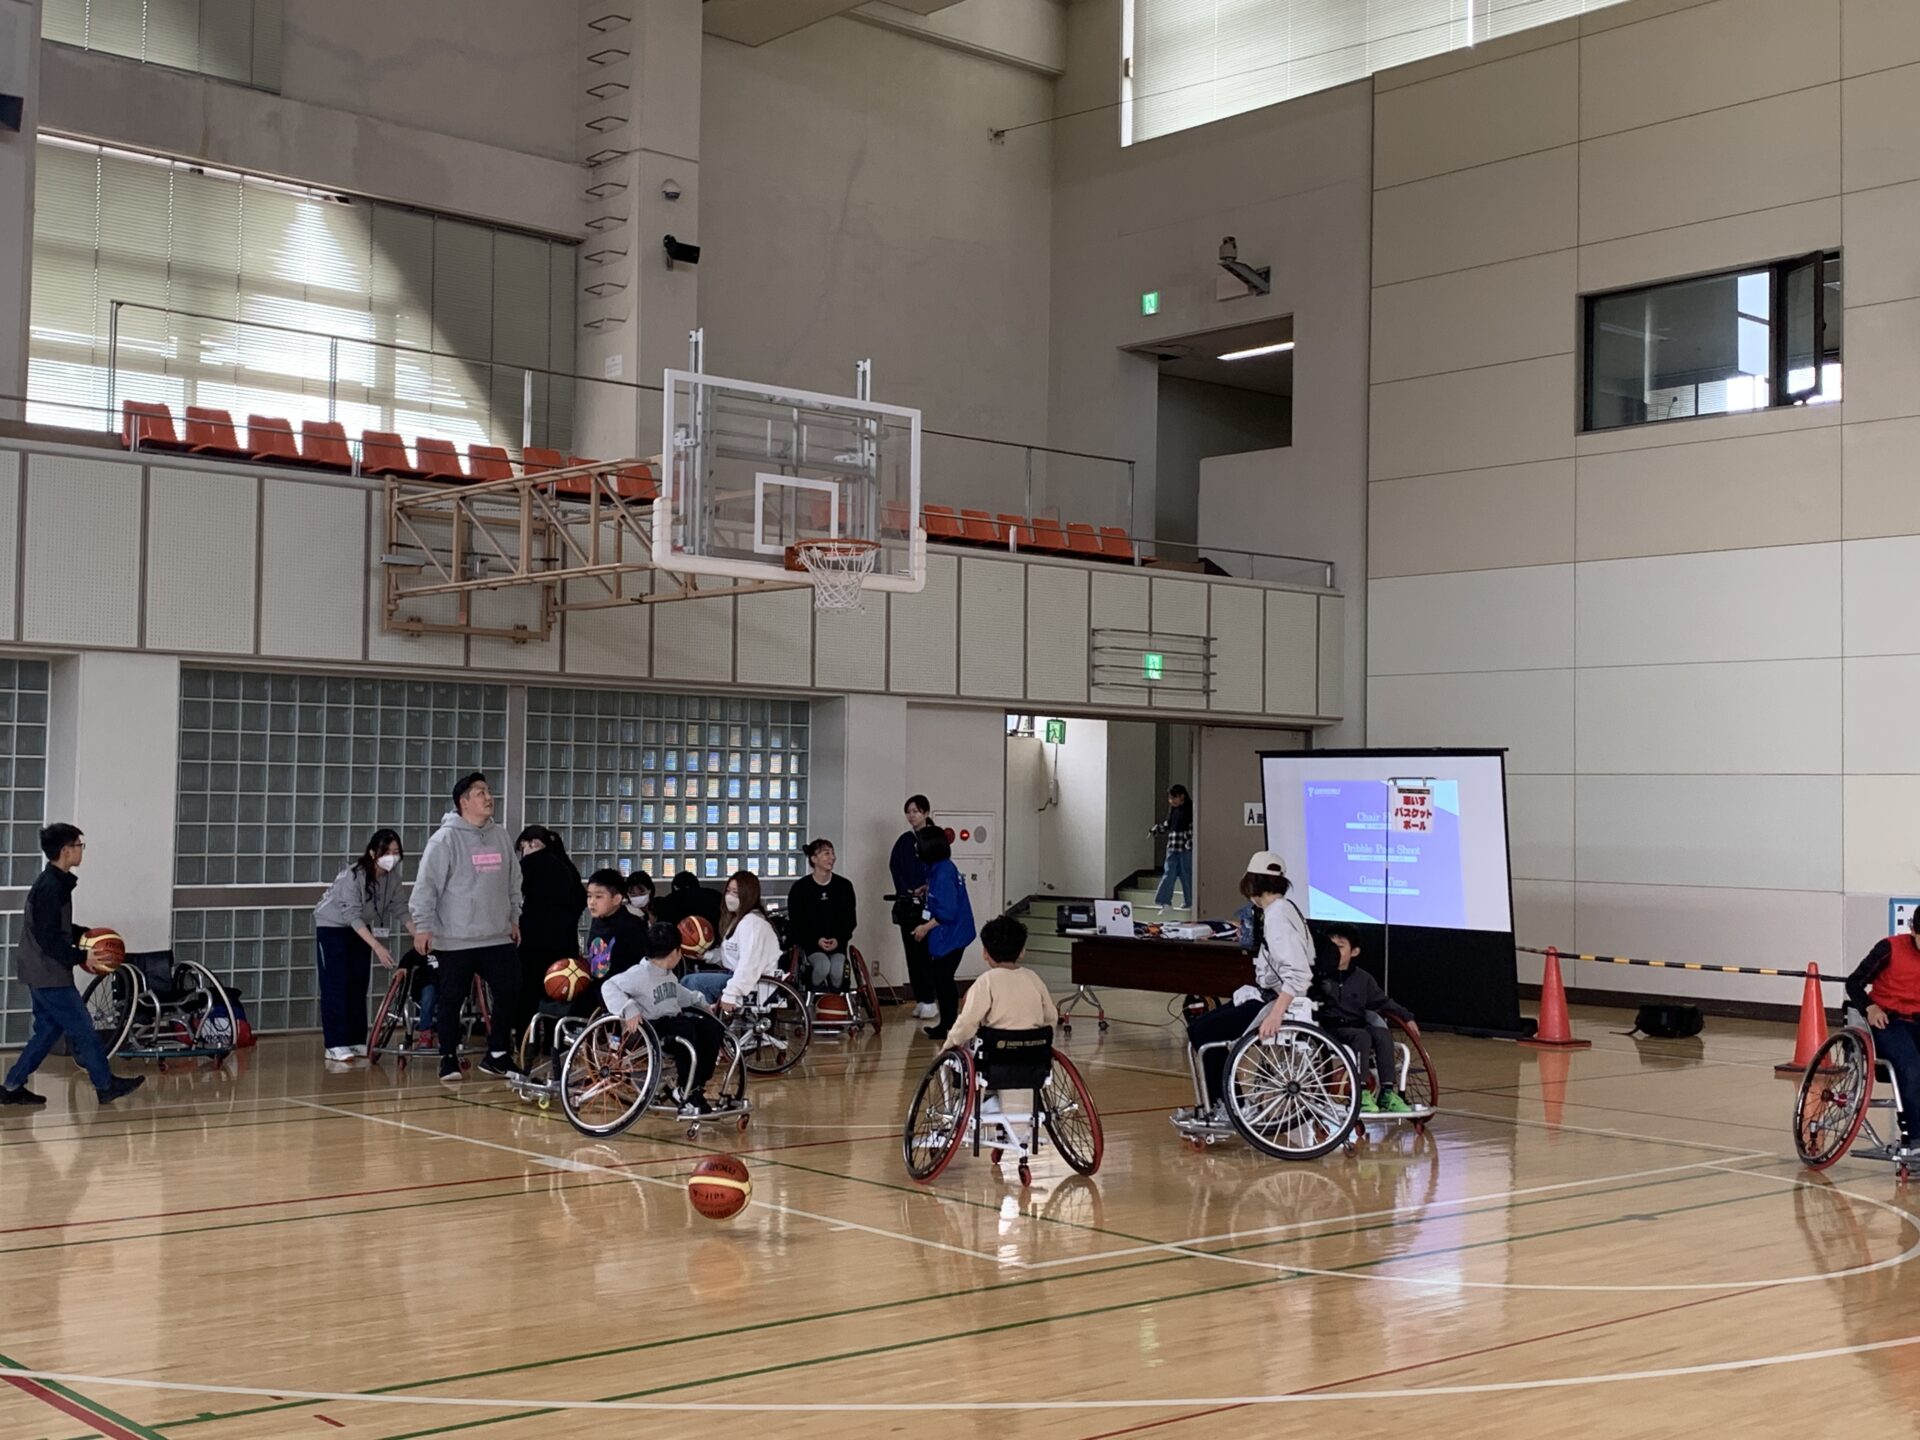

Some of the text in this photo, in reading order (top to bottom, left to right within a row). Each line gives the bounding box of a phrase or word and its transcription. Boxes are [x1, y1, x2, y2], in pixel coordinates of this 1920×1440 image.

[1356, 811, 1380, 821] Chair
[1395, 807, 1433, 819] バスケット
[1403, 819, 1426, 831] ボール
[1343, 843, 1373, 854] Dribble
[1396, 844, 1421, 855] Shoot
[1359, 875, 1385, 886] Game
